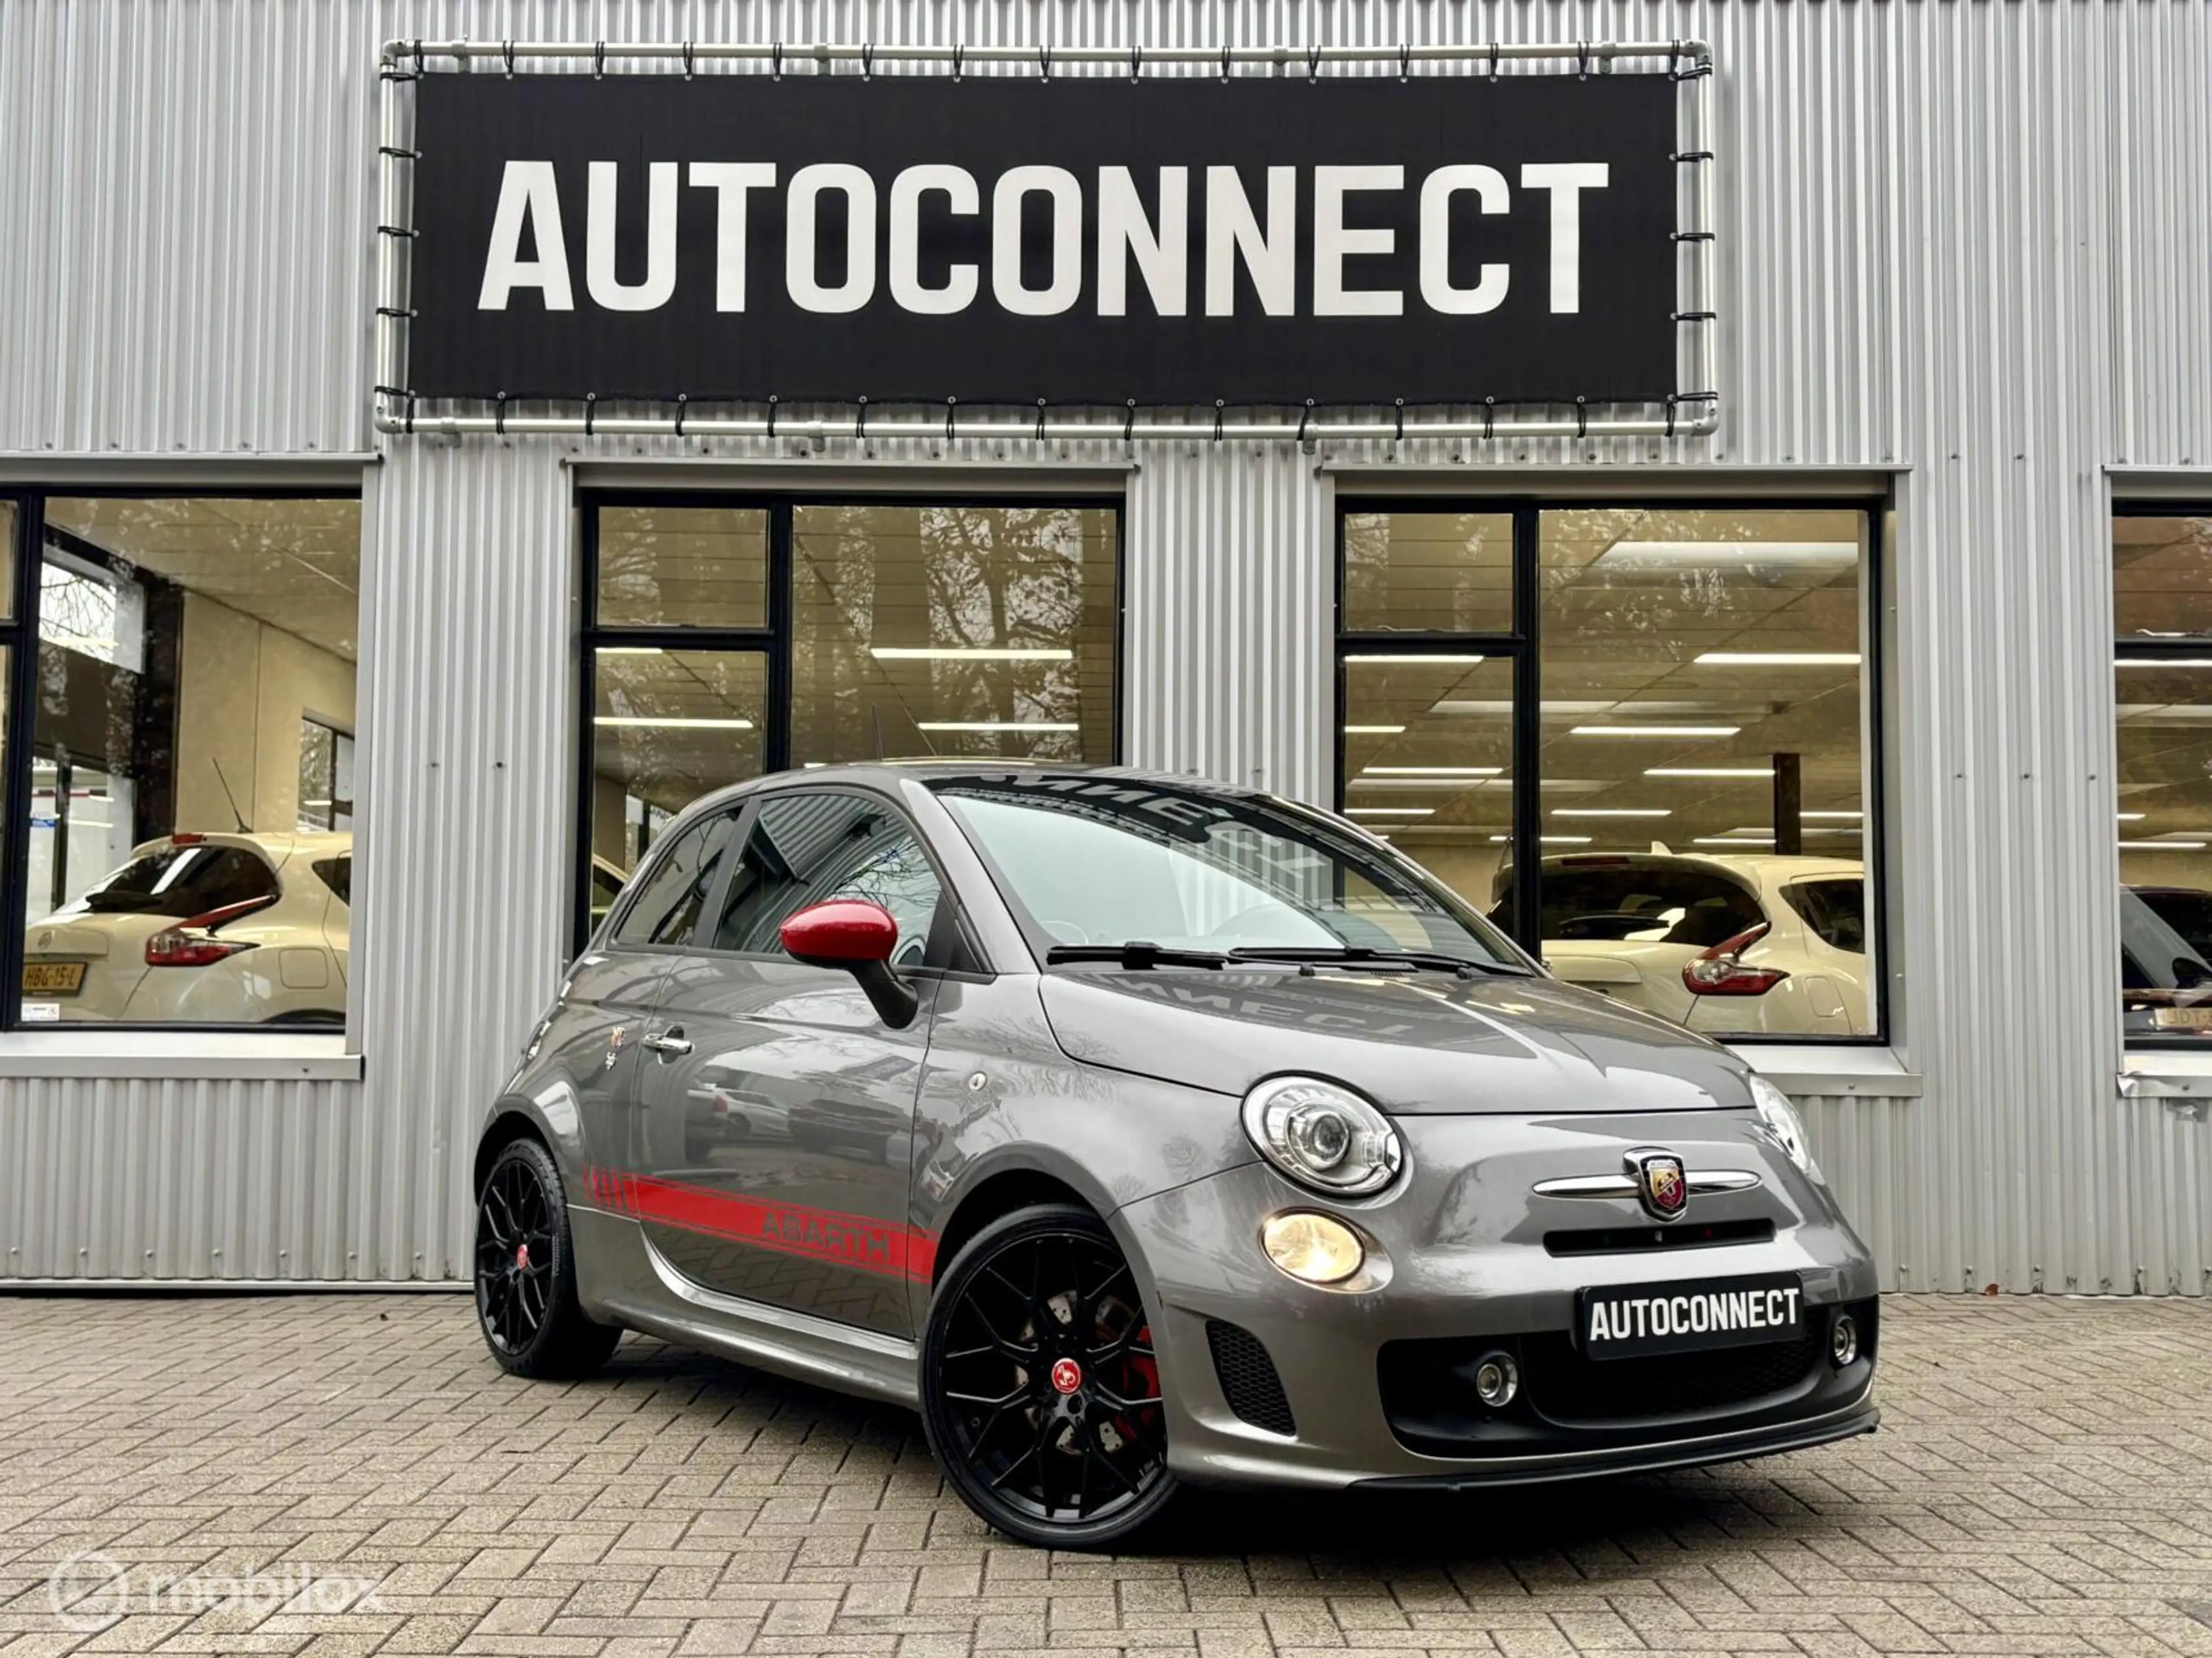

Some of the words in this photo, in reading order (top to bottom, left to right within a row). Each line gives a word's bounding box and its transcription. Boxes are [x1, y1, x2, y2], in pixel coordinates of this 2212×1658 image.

[478, 160, 1609, 316] AUTOCONNECT
[762, 1212, 891, 1263] ABARTH
[1589, 1287, 1800, 1342] AUTOCONNECT
